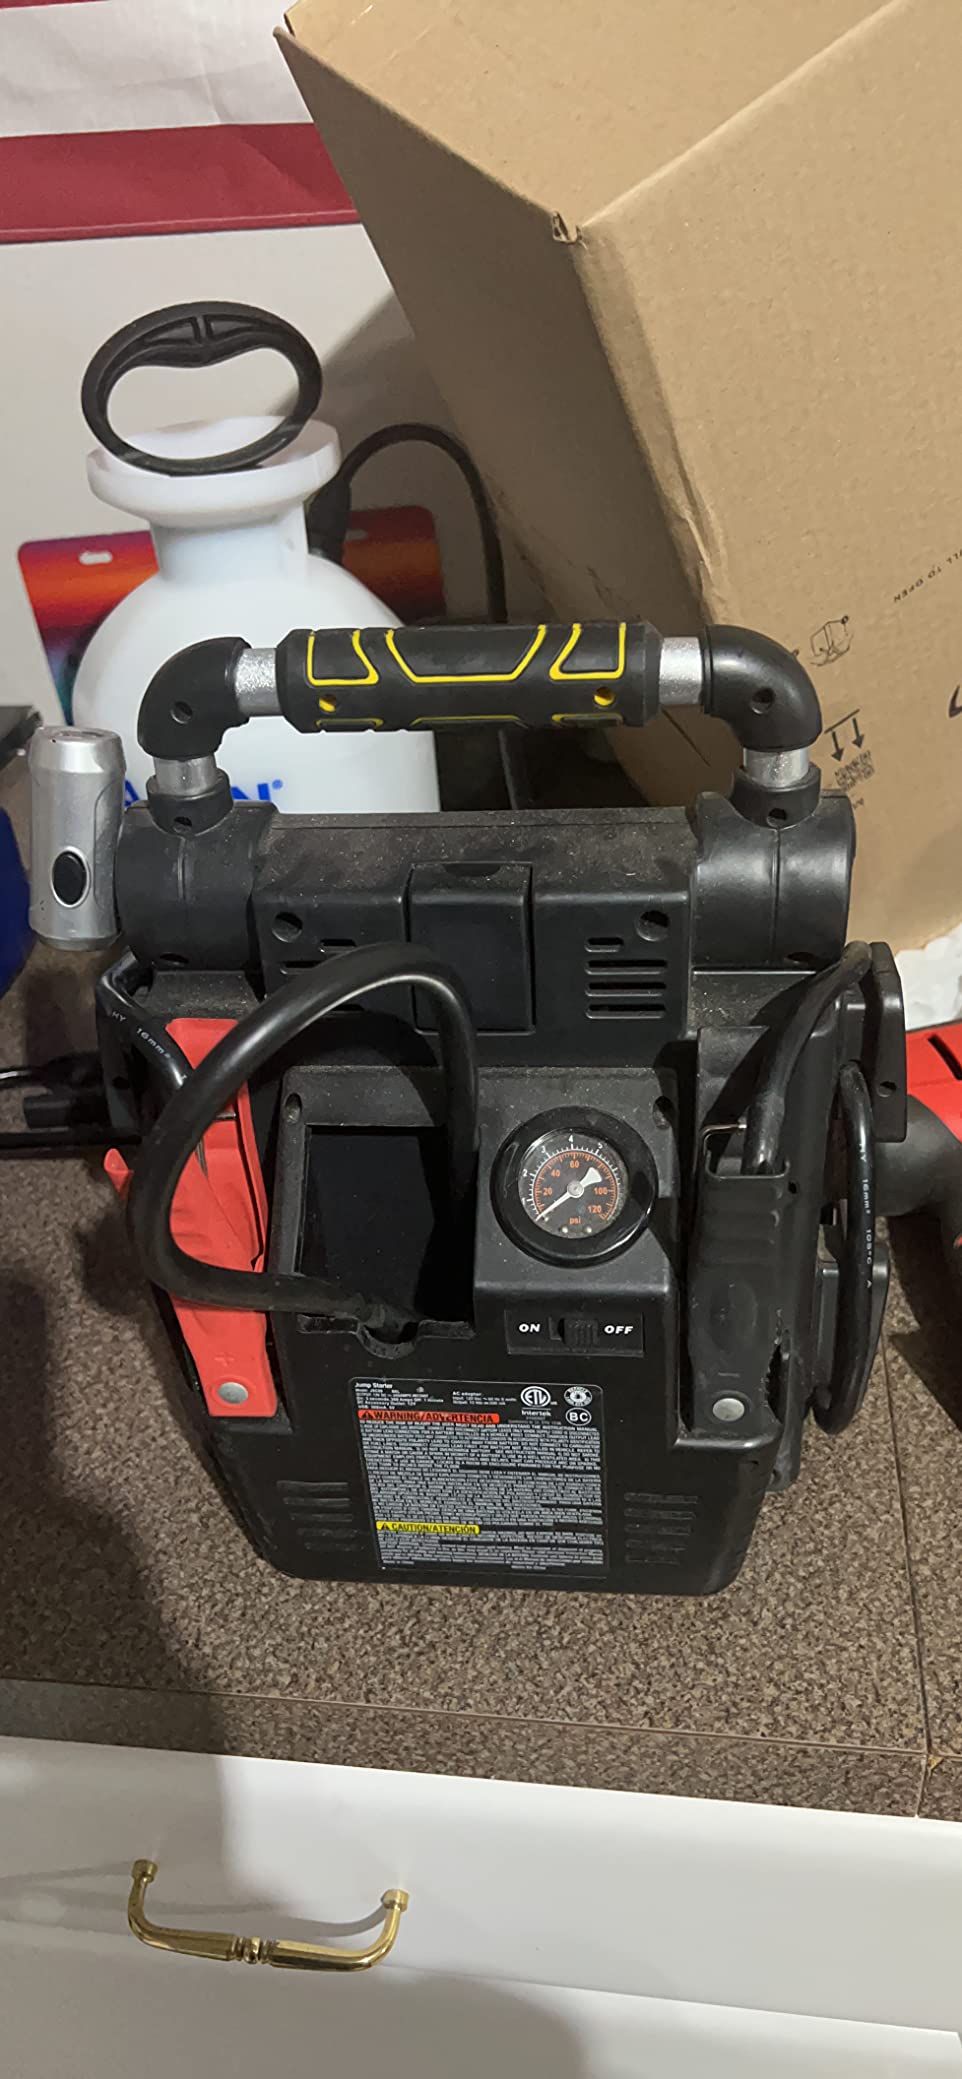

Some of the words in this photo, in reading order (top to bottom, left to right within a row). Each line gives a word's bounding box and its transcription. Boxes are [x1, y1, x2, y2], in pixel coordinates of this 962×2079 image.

[893, 578, 924, 603] OPEN
[568, 1134, 574, 1143] 4
[570, 1160, 580, 1168] 60
[522, 1169, 528, 1177] 2
[551, 1169, 561, 1177] 40
[543, 1188, 553, 1196] 20
[594, 1187, 608, 1195] 100
[588, 1205, 602, 1213] 120
[569, 1216, 581, 1225] psi
[519, 1323, 541, 1333] ON
[604, 1325, 633, 1335] OFF
[570, 1412, 588, 1422] BC
[391, 1522, 476, 1534] CAUTION/ATENCIÓN
